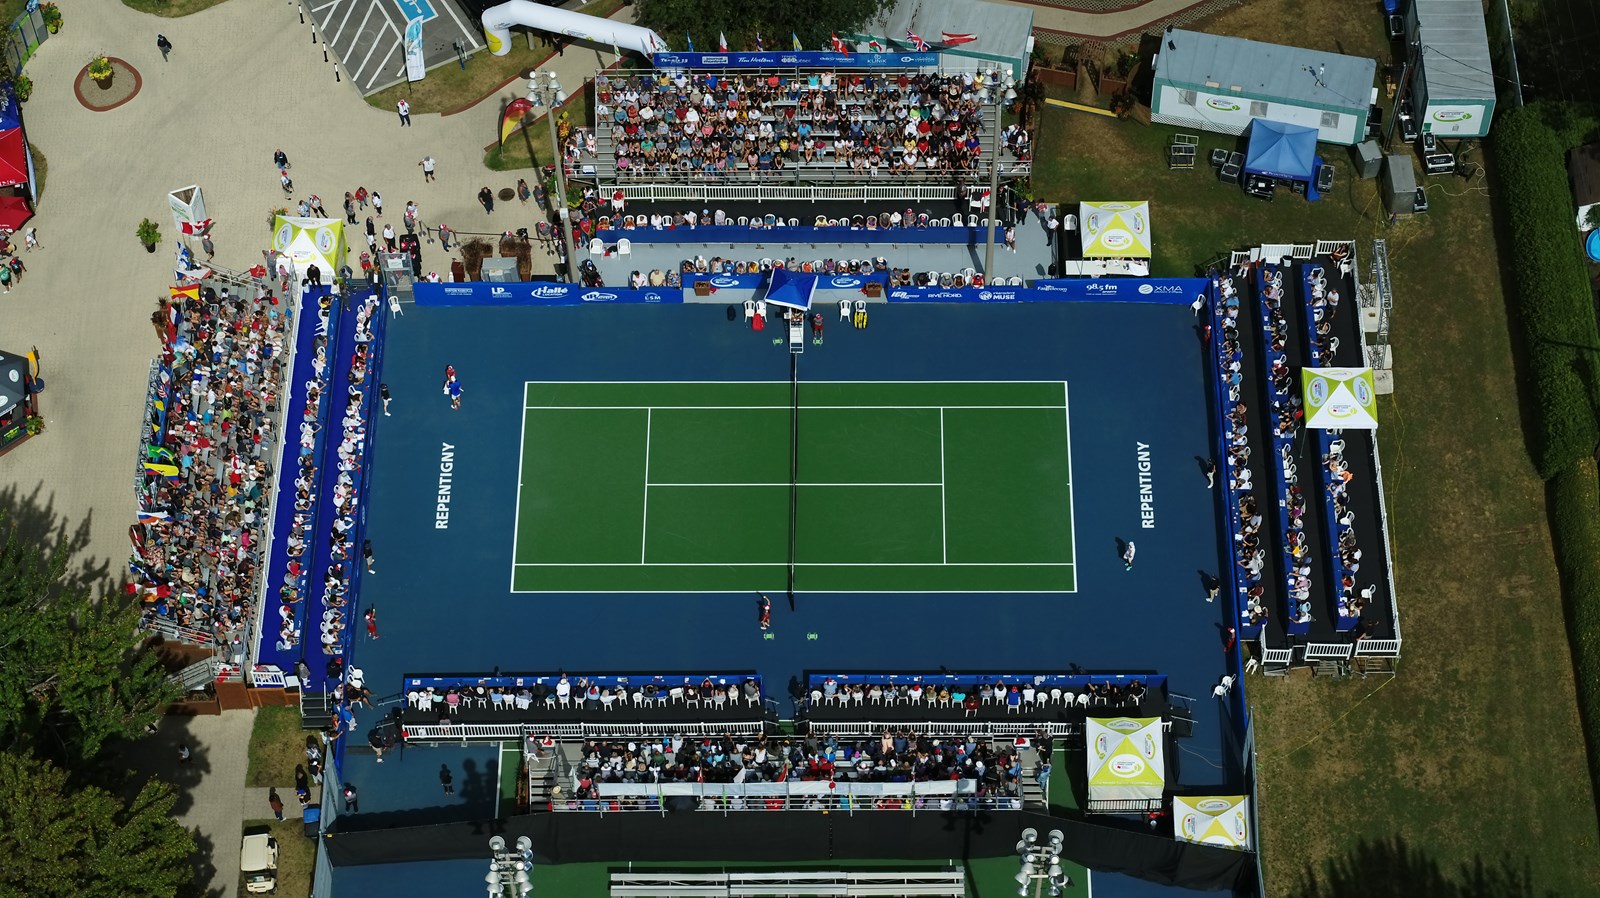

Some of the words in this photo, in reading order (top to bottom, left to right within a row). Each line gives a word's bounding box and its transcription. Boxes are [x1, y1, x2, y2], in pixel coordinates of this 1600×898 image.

[537, 286, 568, 295] Hallé
[1086, 283, 1104, 292] 98.5
[435, 442, 455, 529] REPENTIGNY
[1136, 441, 1155, 529] REPENTIGNY
